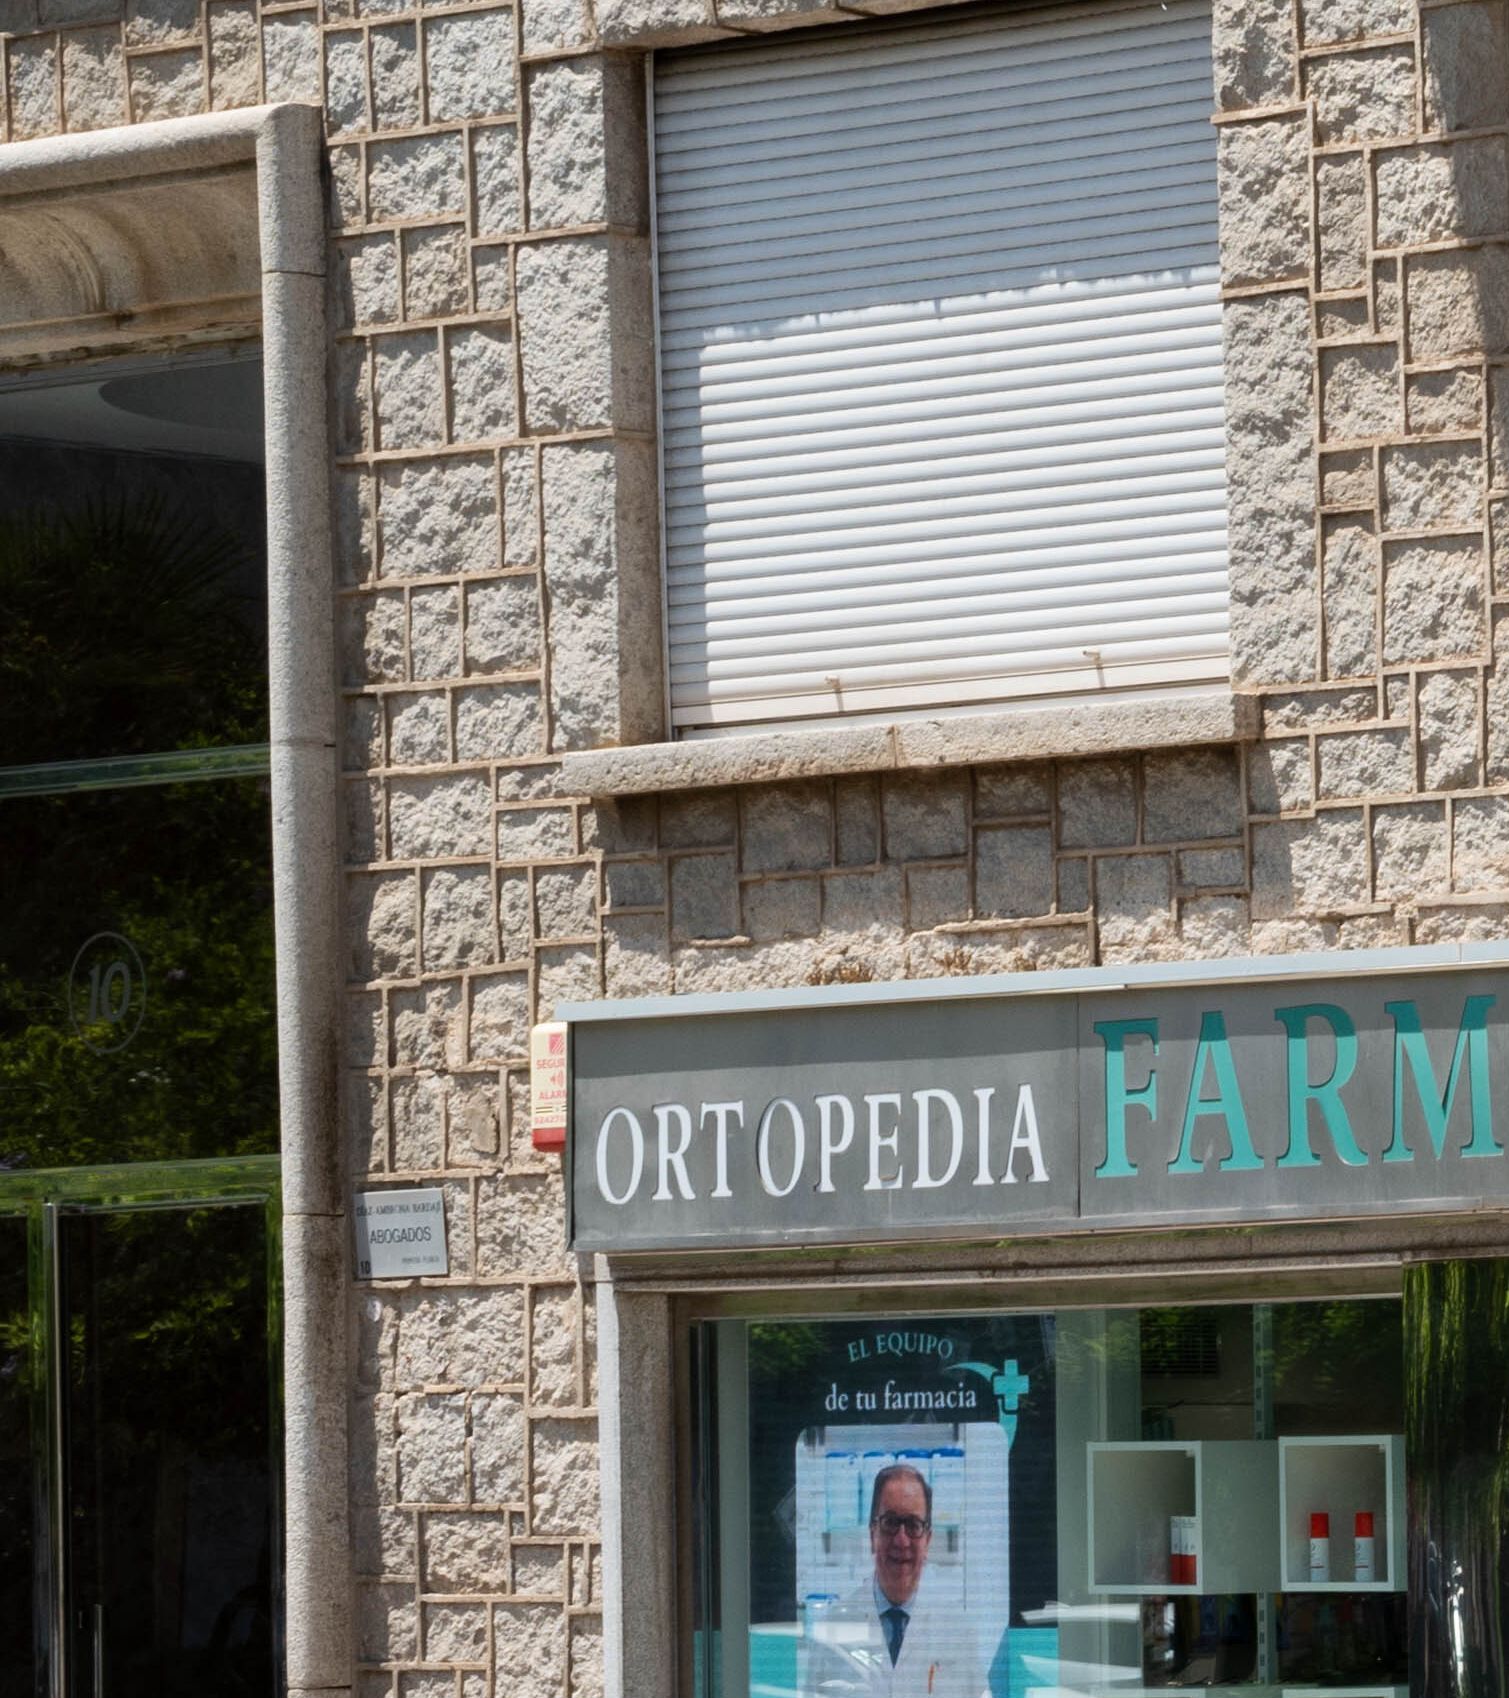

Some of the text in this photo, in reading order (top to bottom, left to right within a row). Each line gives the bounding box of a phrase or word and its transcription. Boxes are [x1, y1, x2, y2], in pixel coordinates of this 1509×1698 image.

[86, 961, 131, 1025] 10
[595, 1082, 1051, 1206] ORTOPEDIA
[370, 1226, 432, 1244] ABOGADOS
[360, 1260, 372, 1275] 10
[847, 1332, 953, 1363] EL EQUIPO
[825, 1380, 977, 1411] de tu farmacia
